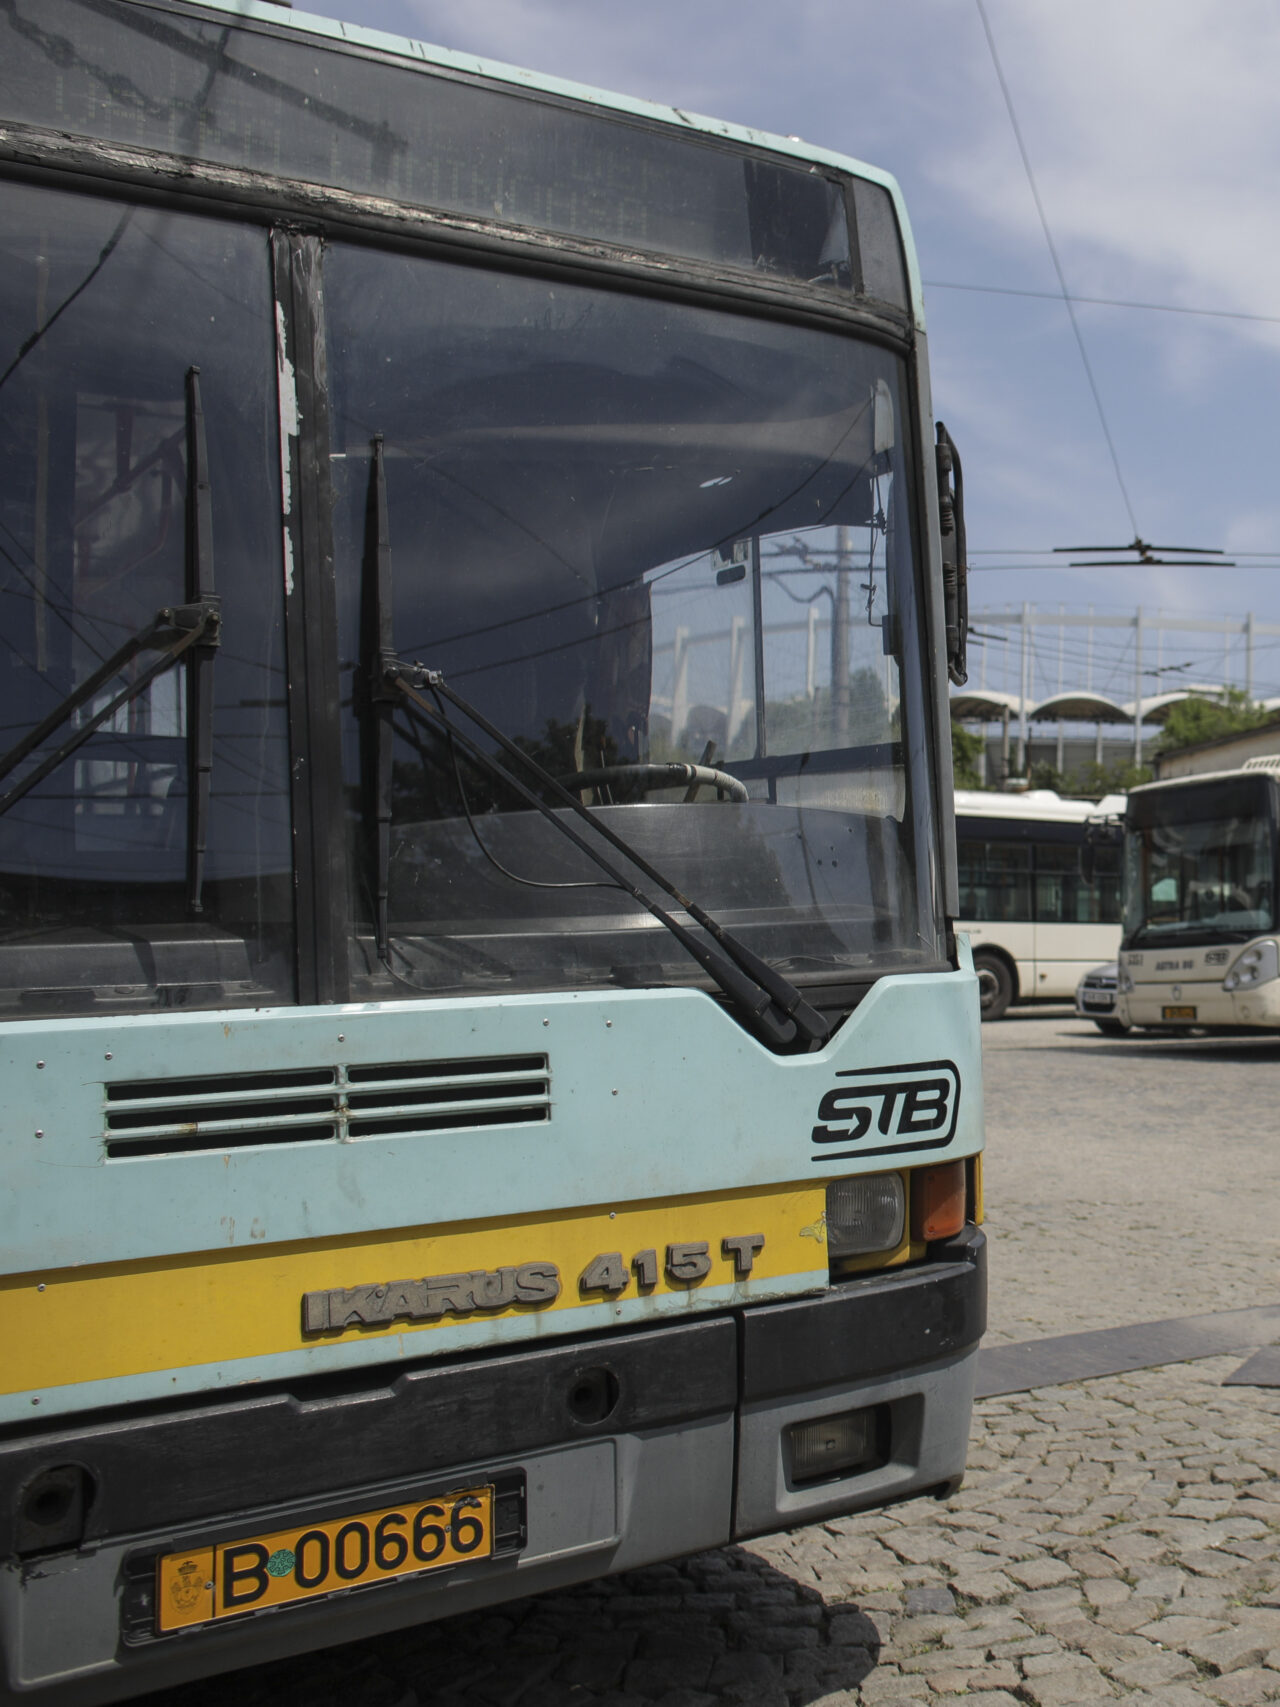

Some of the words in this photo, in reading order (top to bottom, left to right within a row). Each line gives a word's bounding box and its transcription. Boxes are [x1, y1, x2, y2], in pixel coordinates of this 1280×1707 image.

[811, 1078, 950, 1144] STB
[302, 1262, 561, 1335] IKARUS
[579, 1241, 710, 1293] 415
[721, 1234, 765, 1272] T
[222, 1542, 270, 1609] B
[294, 1496, 485, 1589] 00666
